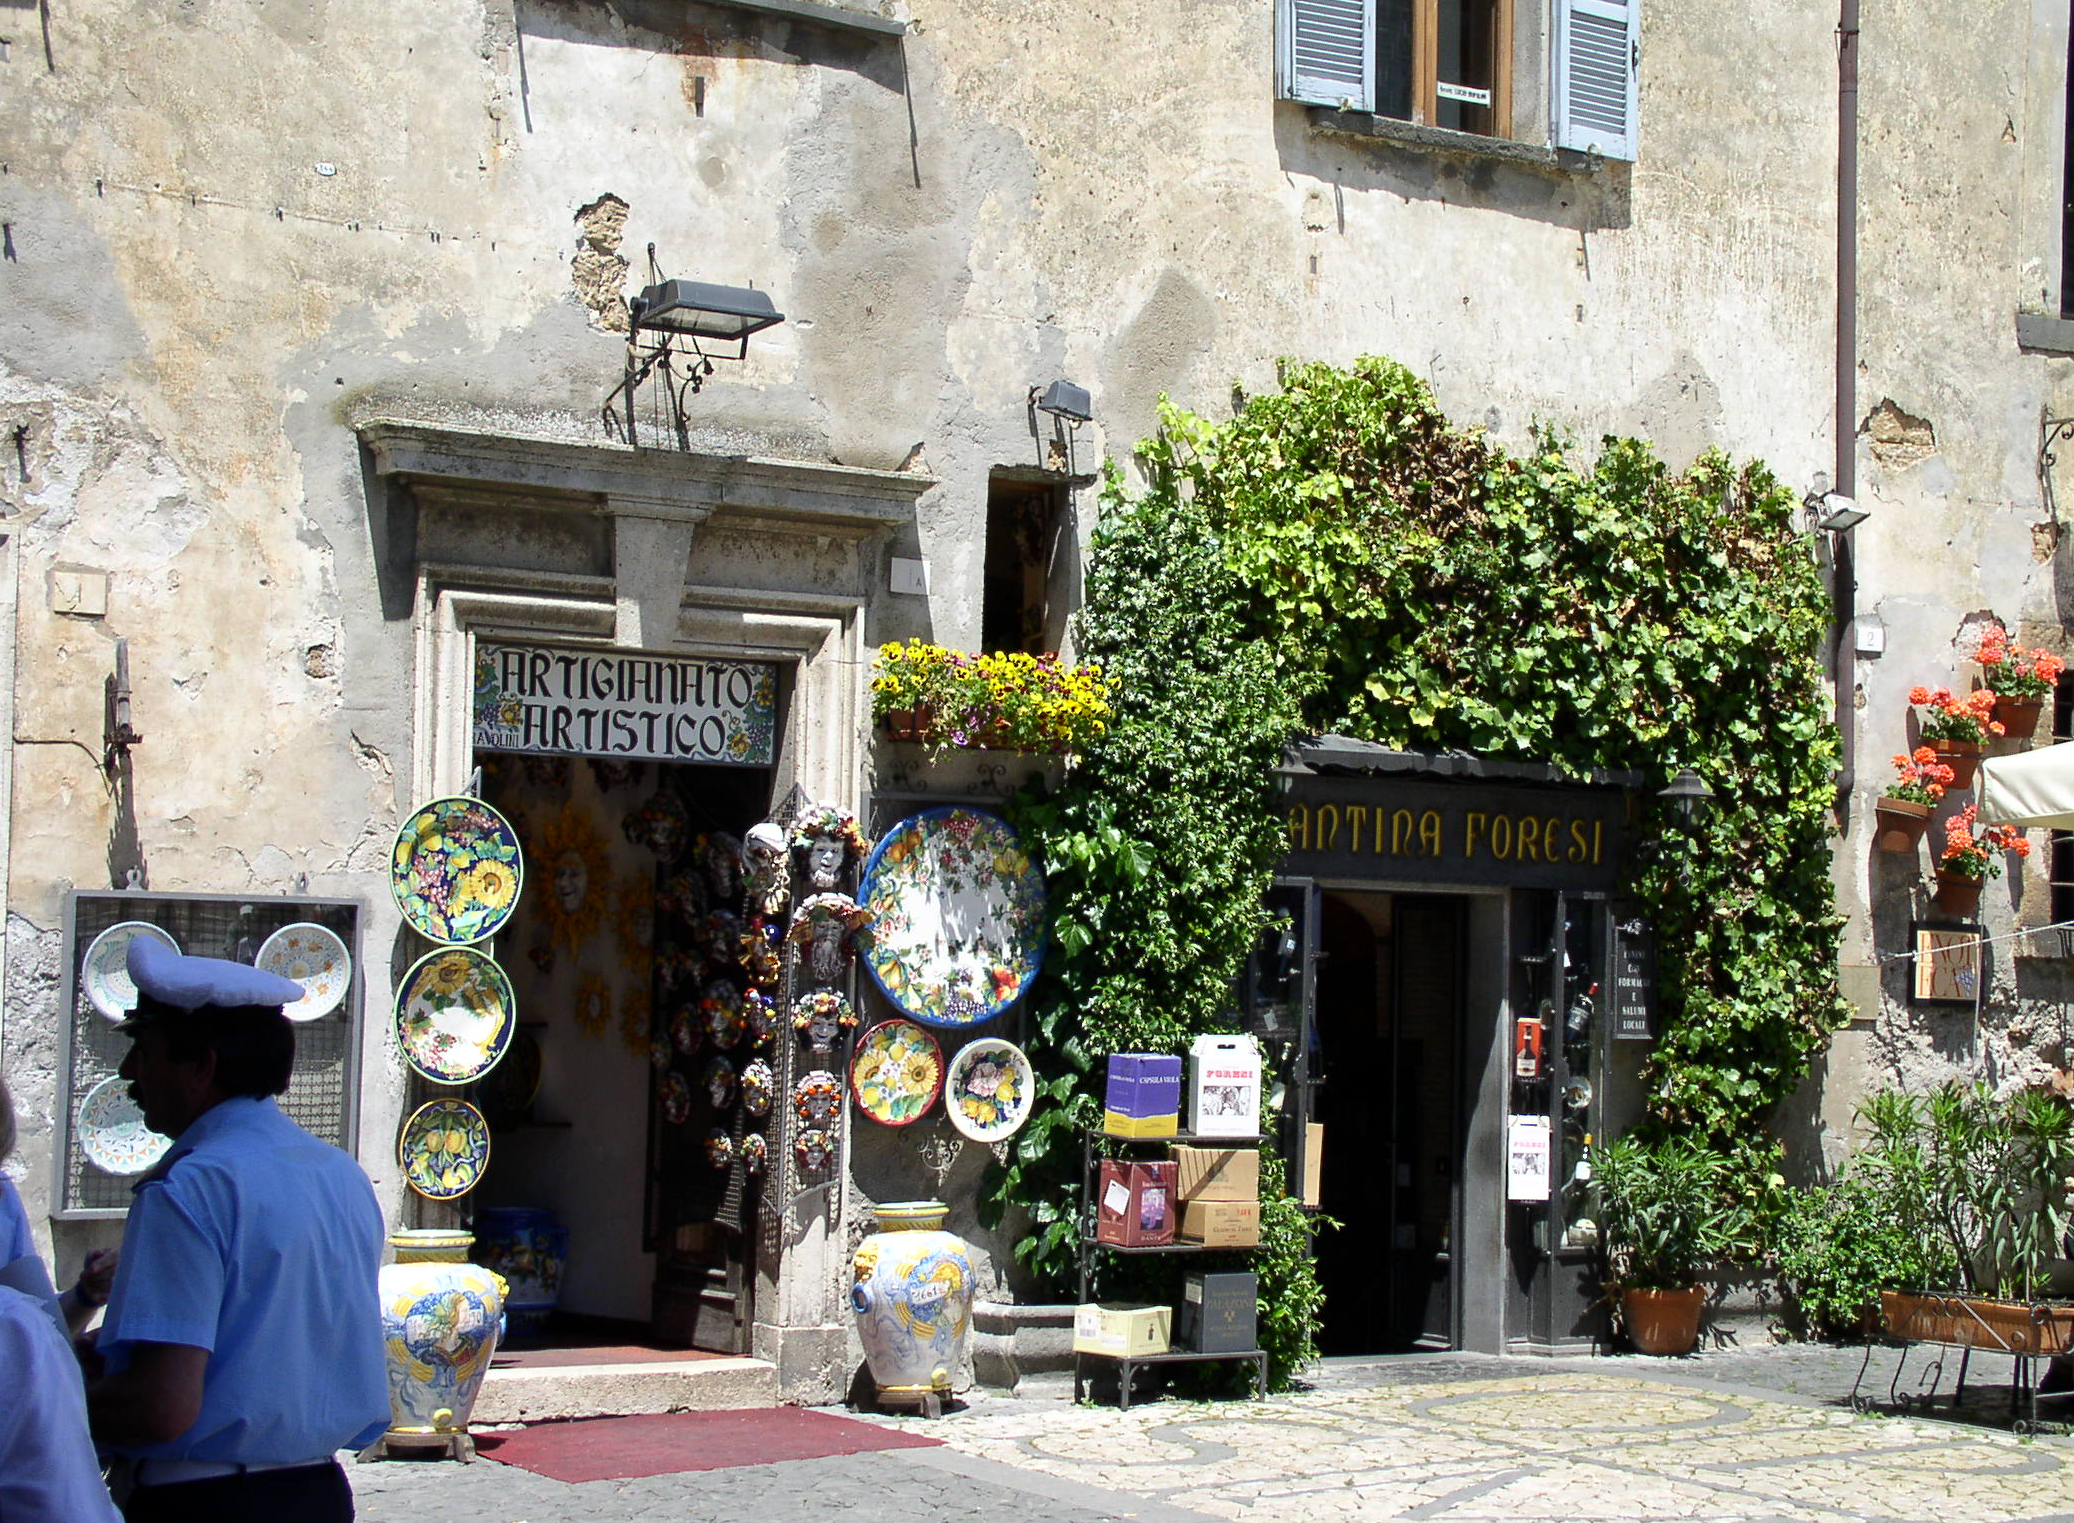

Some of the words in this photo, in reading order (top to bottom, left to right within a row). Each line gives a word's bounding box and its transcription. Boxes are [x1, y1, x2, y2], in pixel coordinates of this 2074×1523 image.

[1867, 631, 1875, 647] 2
[501, 650, 753, 709] ARTIGIANATO
[523, 703, 726, 757] ARTISTICO
[1288, 803, 1441, 856] ANTINA
[1465, 812, 1603, 865] FORESI
